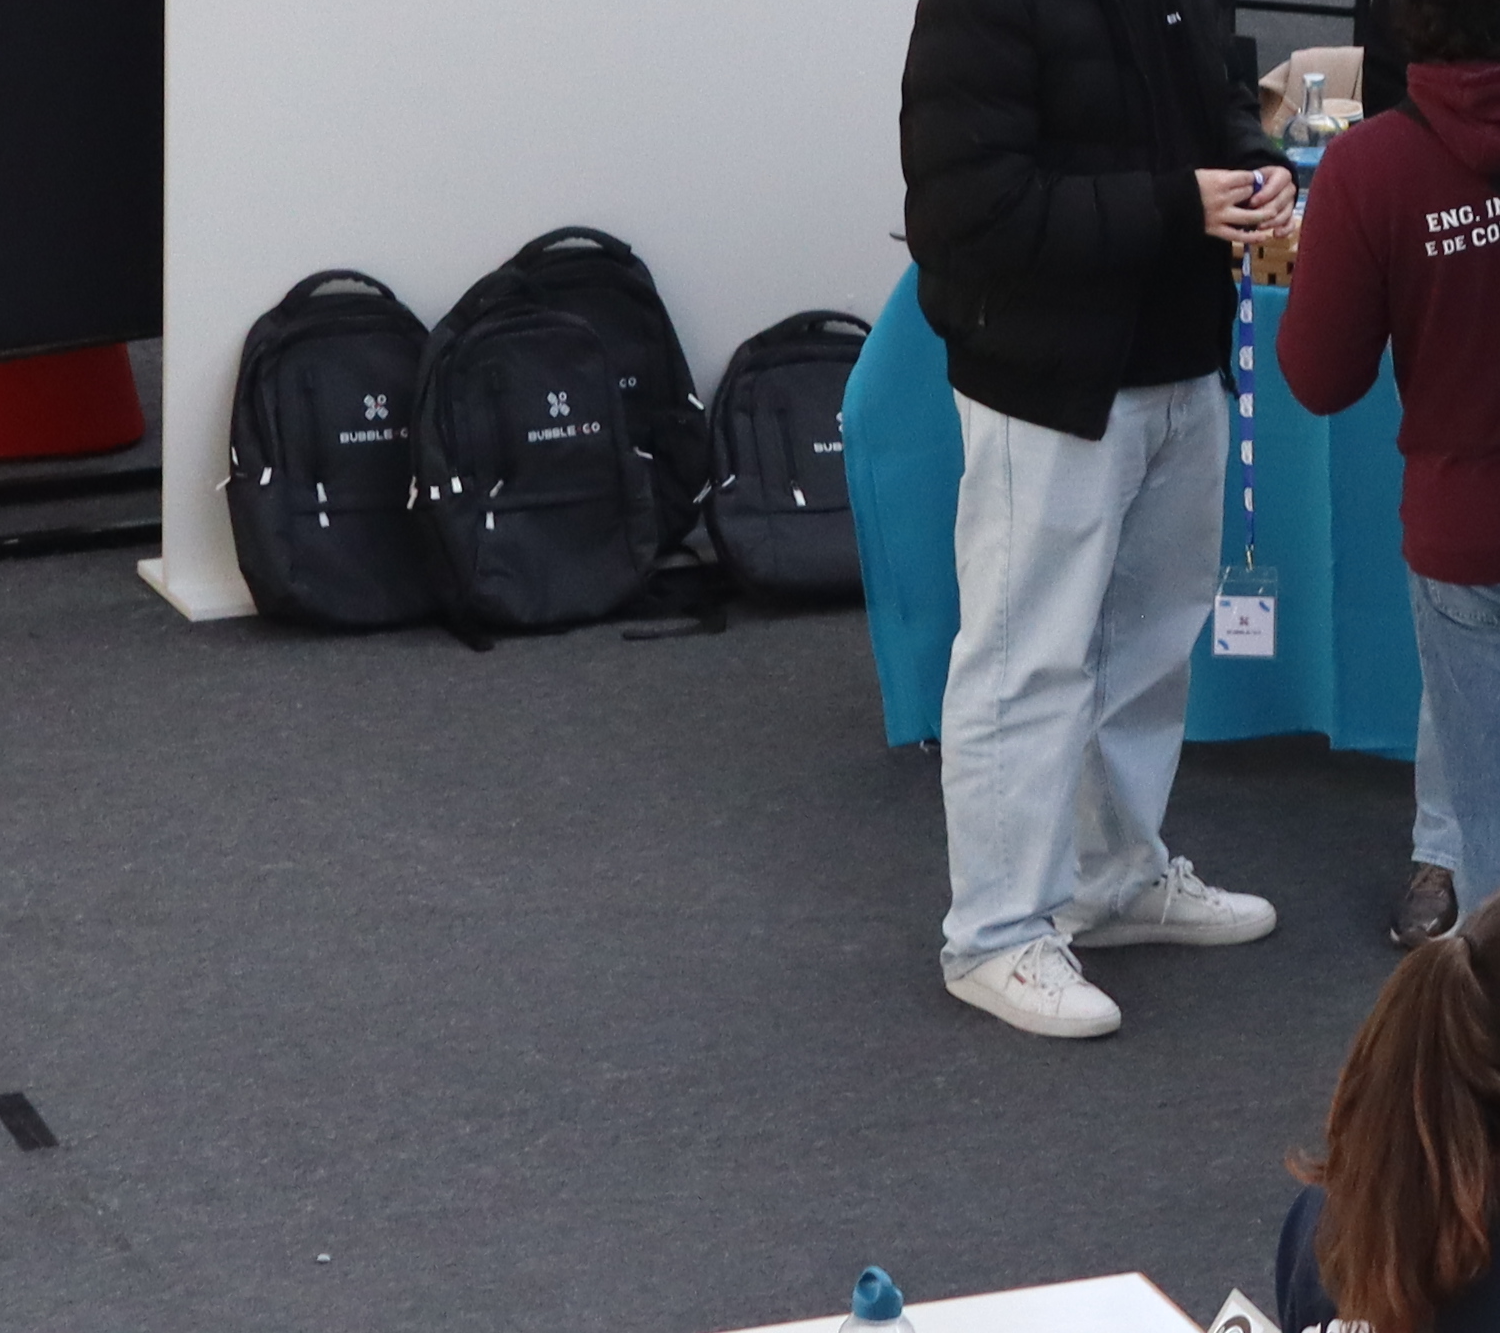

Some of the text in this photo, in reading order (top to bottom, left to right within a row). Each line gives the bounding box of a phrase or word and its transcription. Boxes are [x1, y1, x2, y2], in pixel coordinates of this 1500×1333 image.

[1425, 196, 1481, 232] ENG.
[1424, 240, 1438, 257] E
[1442, 234, 1467, 255] DE
